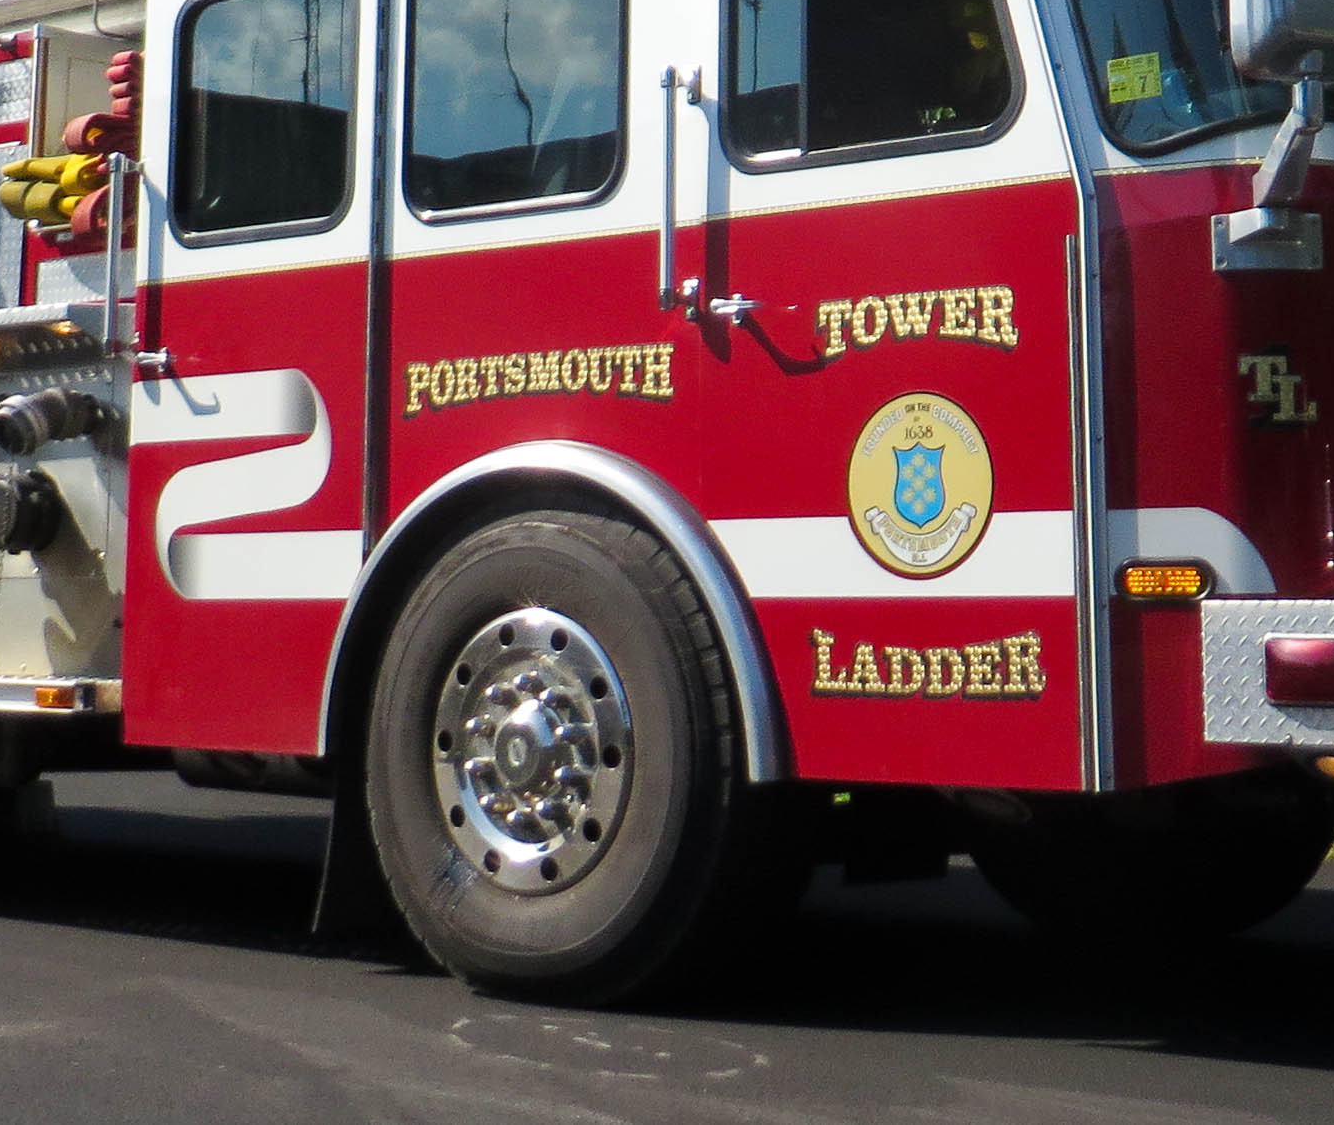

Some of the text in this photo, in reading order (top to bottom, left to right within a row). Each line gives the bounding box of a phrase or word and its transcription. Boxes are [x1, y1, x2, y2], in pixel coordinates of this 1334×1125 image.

[816, 285, 1020, 360] TOWER
[404, 343, 676, 419] PORTSMOUTH
[1238, 354, 1318, 425] TL
[863, 407, 904, 455] FOUNDED
[917, 403, 931, 412] THE
[904, 425, 934, 440] 1638
[810, 627, 1048, 700] LADDER
